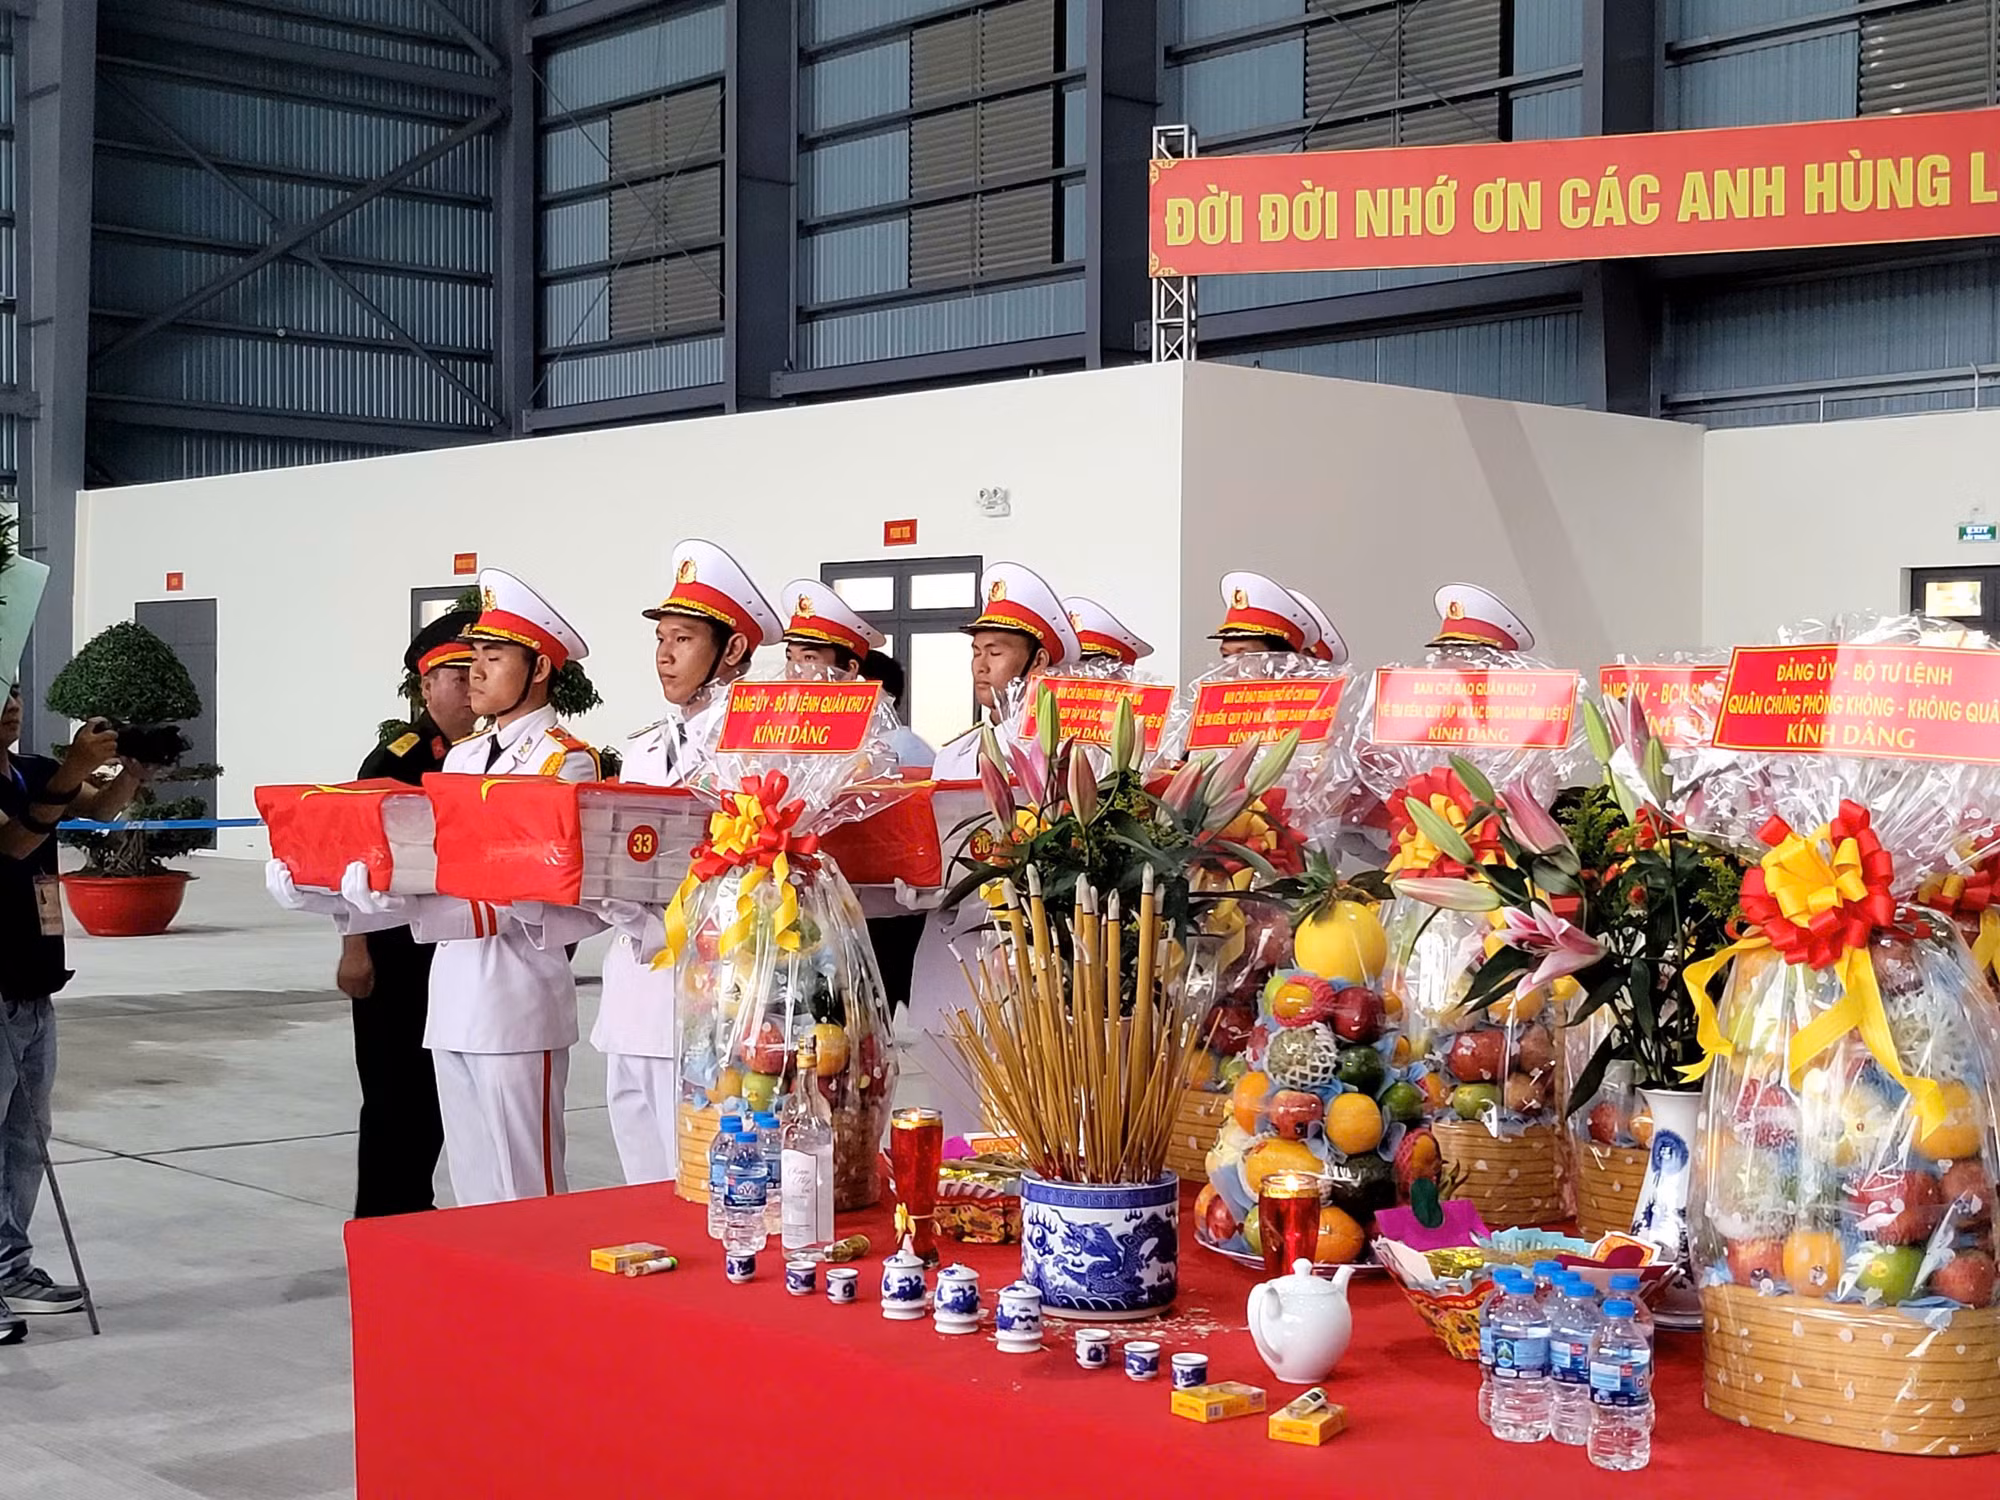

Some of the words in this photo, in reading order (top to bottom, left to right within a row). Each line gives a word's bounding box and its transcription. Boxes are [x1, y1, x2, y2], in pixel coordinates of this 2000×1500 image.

[1165, 184, 1243, 246] ĐỜI
[1258, 179, 1338, 242] ĐỜI
[1355, 174, 1458, 239] NHỚ
[1473, 177, 1543, 233] ƠN
[1559, 165, 1661, 230] CÁC
[1676, 166, 1786, 222] ANH
[1803, 149, 1951, 216] HÙNG
[1777, 657, 1814, 682] ĐẢNG
[1816, 656, 1837, 682] ỦY
[1854, 660, 1875, 684] BỘ
[1881, 662, 1902, 683] TƯ
[1905, 661, 1952, 688] LỆNH
[1413, 682, 1433, 695] BAN
[1476, 679, 1504, 696] QUÂN
[1505, 682, 1528, 696] KHU
[1661, 683, 1689, 704] BCH
[732, 688, 757, 713] ĐẢNG
[756, 688, 770, 713] ỦY
[774, 691, 787, 716] BỘ
[796, 691, 821, 716] LỆNH
[820, 692, 848, 713] QUÂN
[846, 695, 866, 713] KHU
[863, 695, 873, 713] 7
[1728, 691, 1764, 715] QUÂN
[1764, 688, 1801, 715] CHỦNG
[1803, 690, 1843, 715] PHÒNG
[1846, 691, 1894, 717] KHÔNG
[1907, 695, 1962, 721] KHÔNG
[752, 719, 788, 743] KÍNH
[787, 719, 831, 744] DÂNG
[1428, 722, 1463, 740] KÍNH
[1467, 724, 1509, 742] DÂNG
[1786, 717, 1836, 745] KÍNH
[1843, 720, 1916, 749] DÂNG
[633, 833, 653, 853] 33
